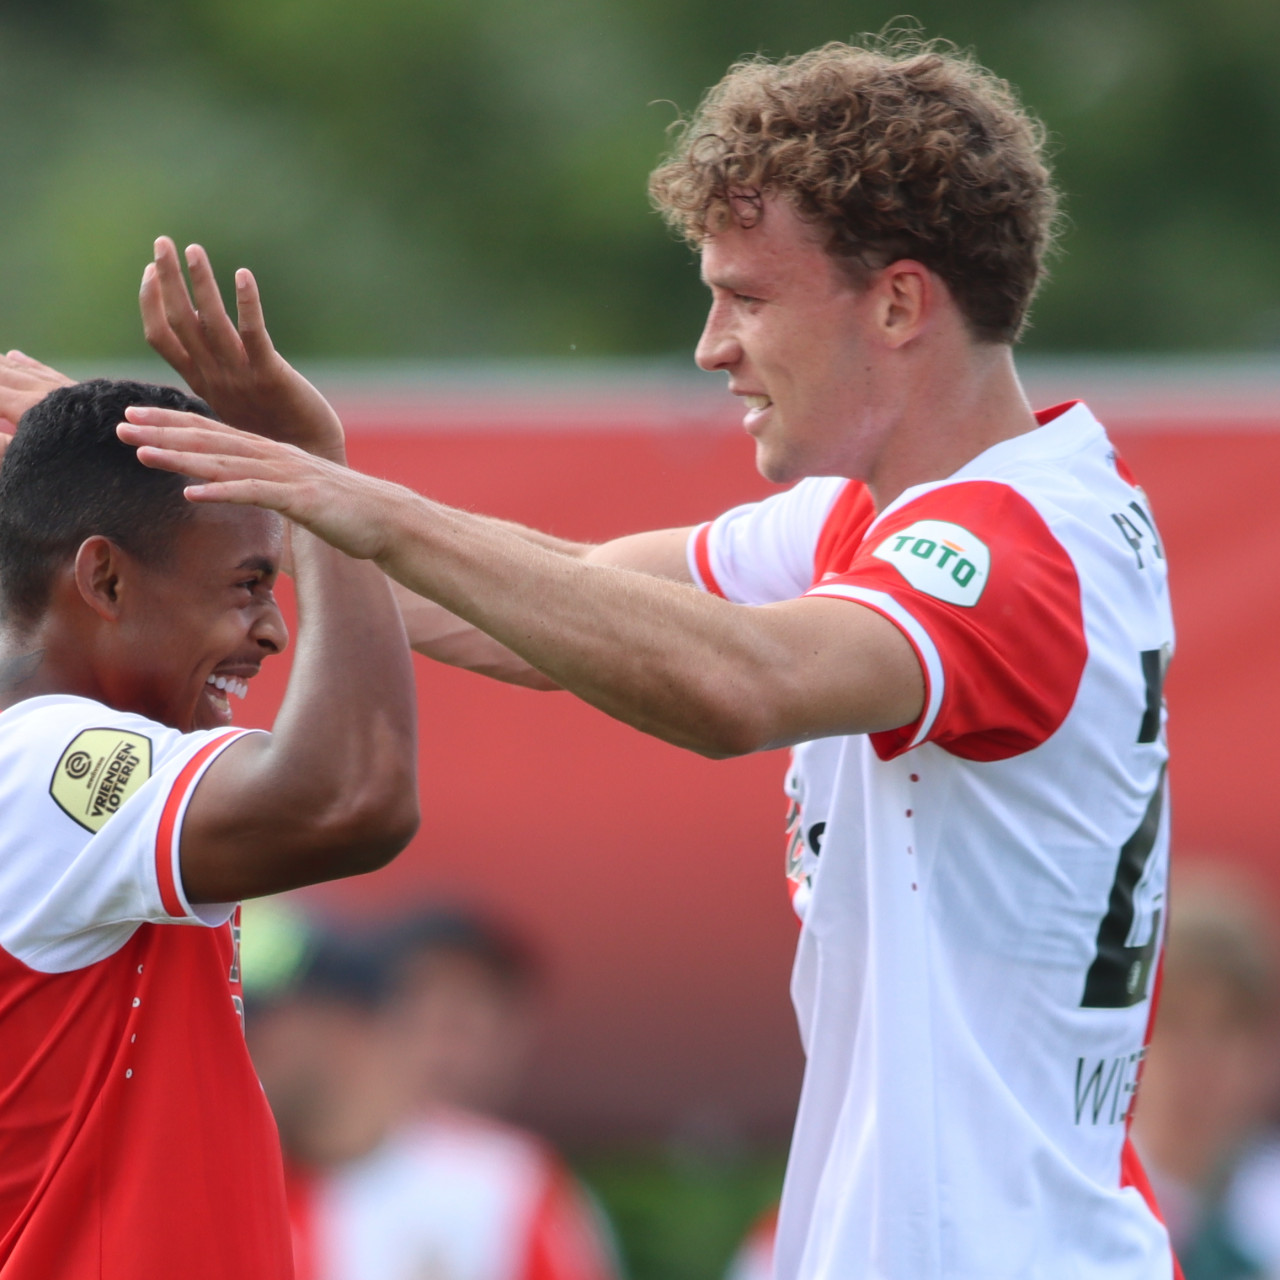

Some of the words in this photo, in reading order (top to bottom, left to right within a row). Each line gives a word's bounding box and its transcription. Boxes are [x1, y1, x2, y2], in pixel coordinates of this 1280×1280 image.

[892, 535, 977, 588] TOTO
[90, 742, 137, 817] VRIENDEN
[105, 755, 140, 814] LOTERIJ
